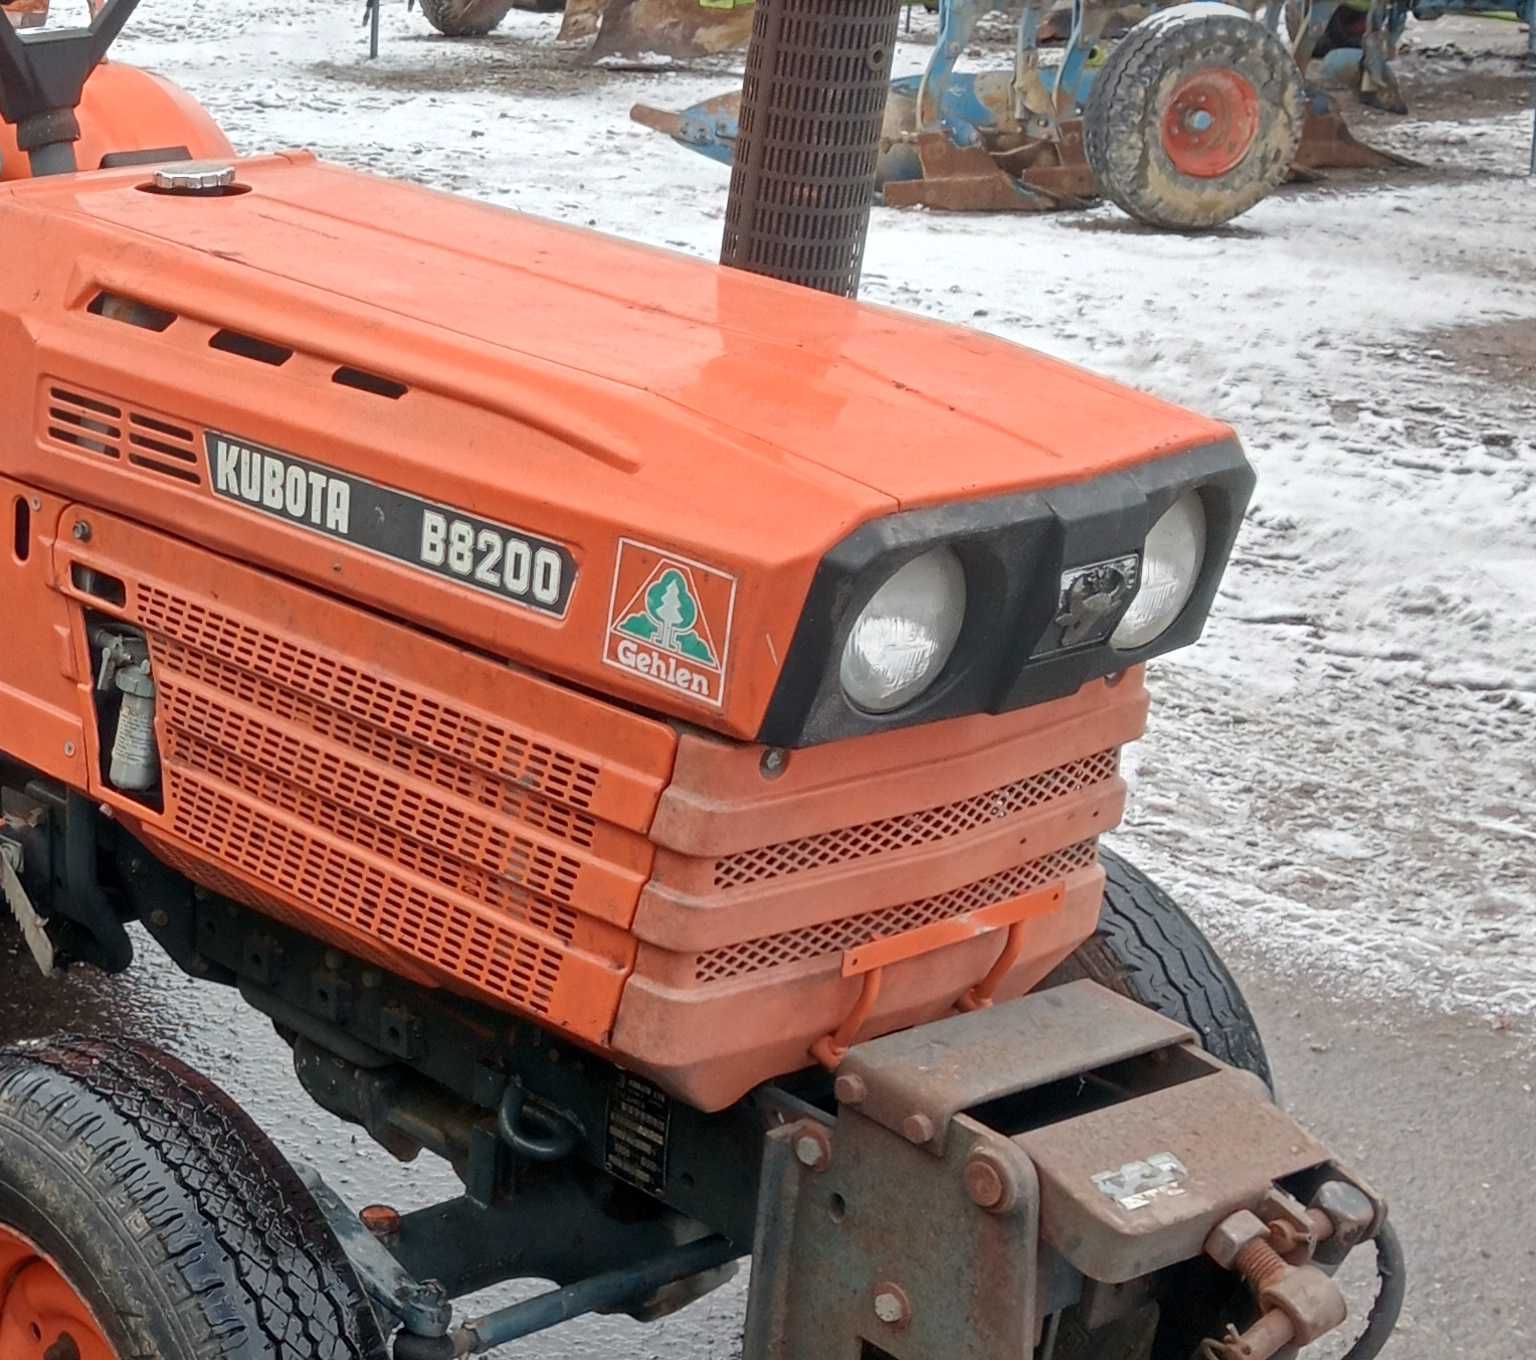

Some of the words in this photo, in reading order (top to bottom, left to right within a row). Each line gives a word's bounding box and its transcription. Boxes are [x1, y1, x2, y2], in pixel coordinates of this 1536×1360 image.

[215, 440, 351, 535] KUBOTA
[419, 508, 562, 606] B8200
[616, 639, 710, 697] Gehlen
